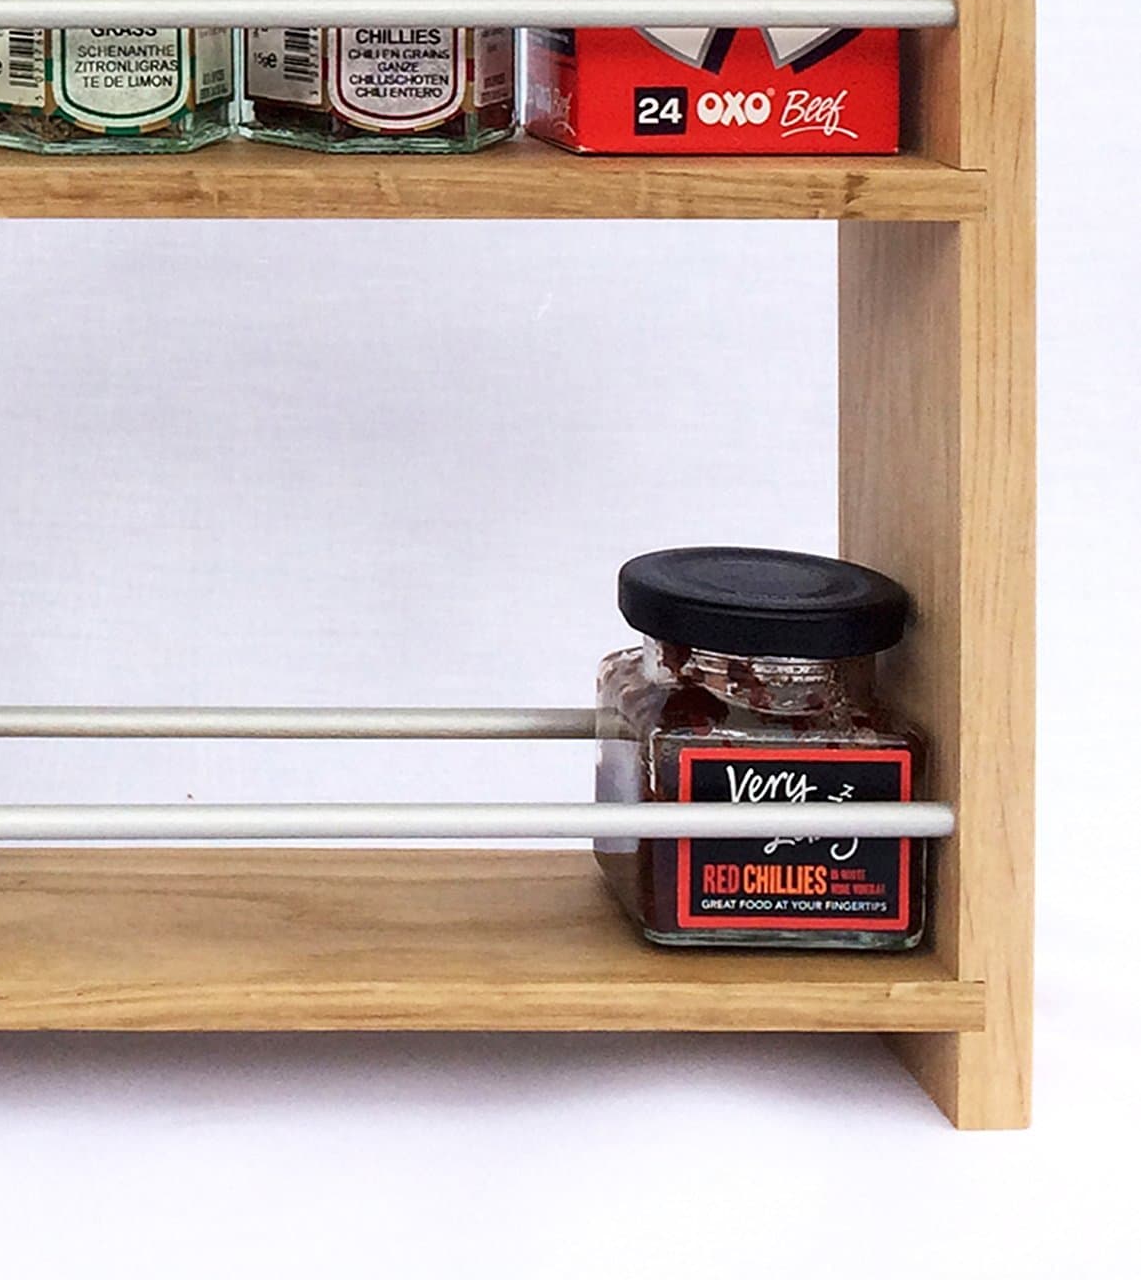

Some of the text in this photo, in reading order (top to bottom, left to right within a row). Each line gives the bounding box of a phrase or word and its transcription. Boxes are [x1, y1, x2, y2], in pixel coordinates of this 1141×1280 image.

[356, 29, 441, 44] CHILLIES
[77, 45, 175, 58] SCHENANTHE
[403, 49, 450, 59] GRAINS
[378, 61, 419, 72] GANZE
[82, 75, 172, 88] TE DE LIMON
[390, 87, 443, 98] ENTERO
[637, 90, 848, 131] 24 OXO Beef
[725, 765, 818, 803] Very
[702, 864, 828, 895] RED CHILLIES
[701, 899, 888, 912] GREAT FOOD AT YOUR FINGERTIPS
